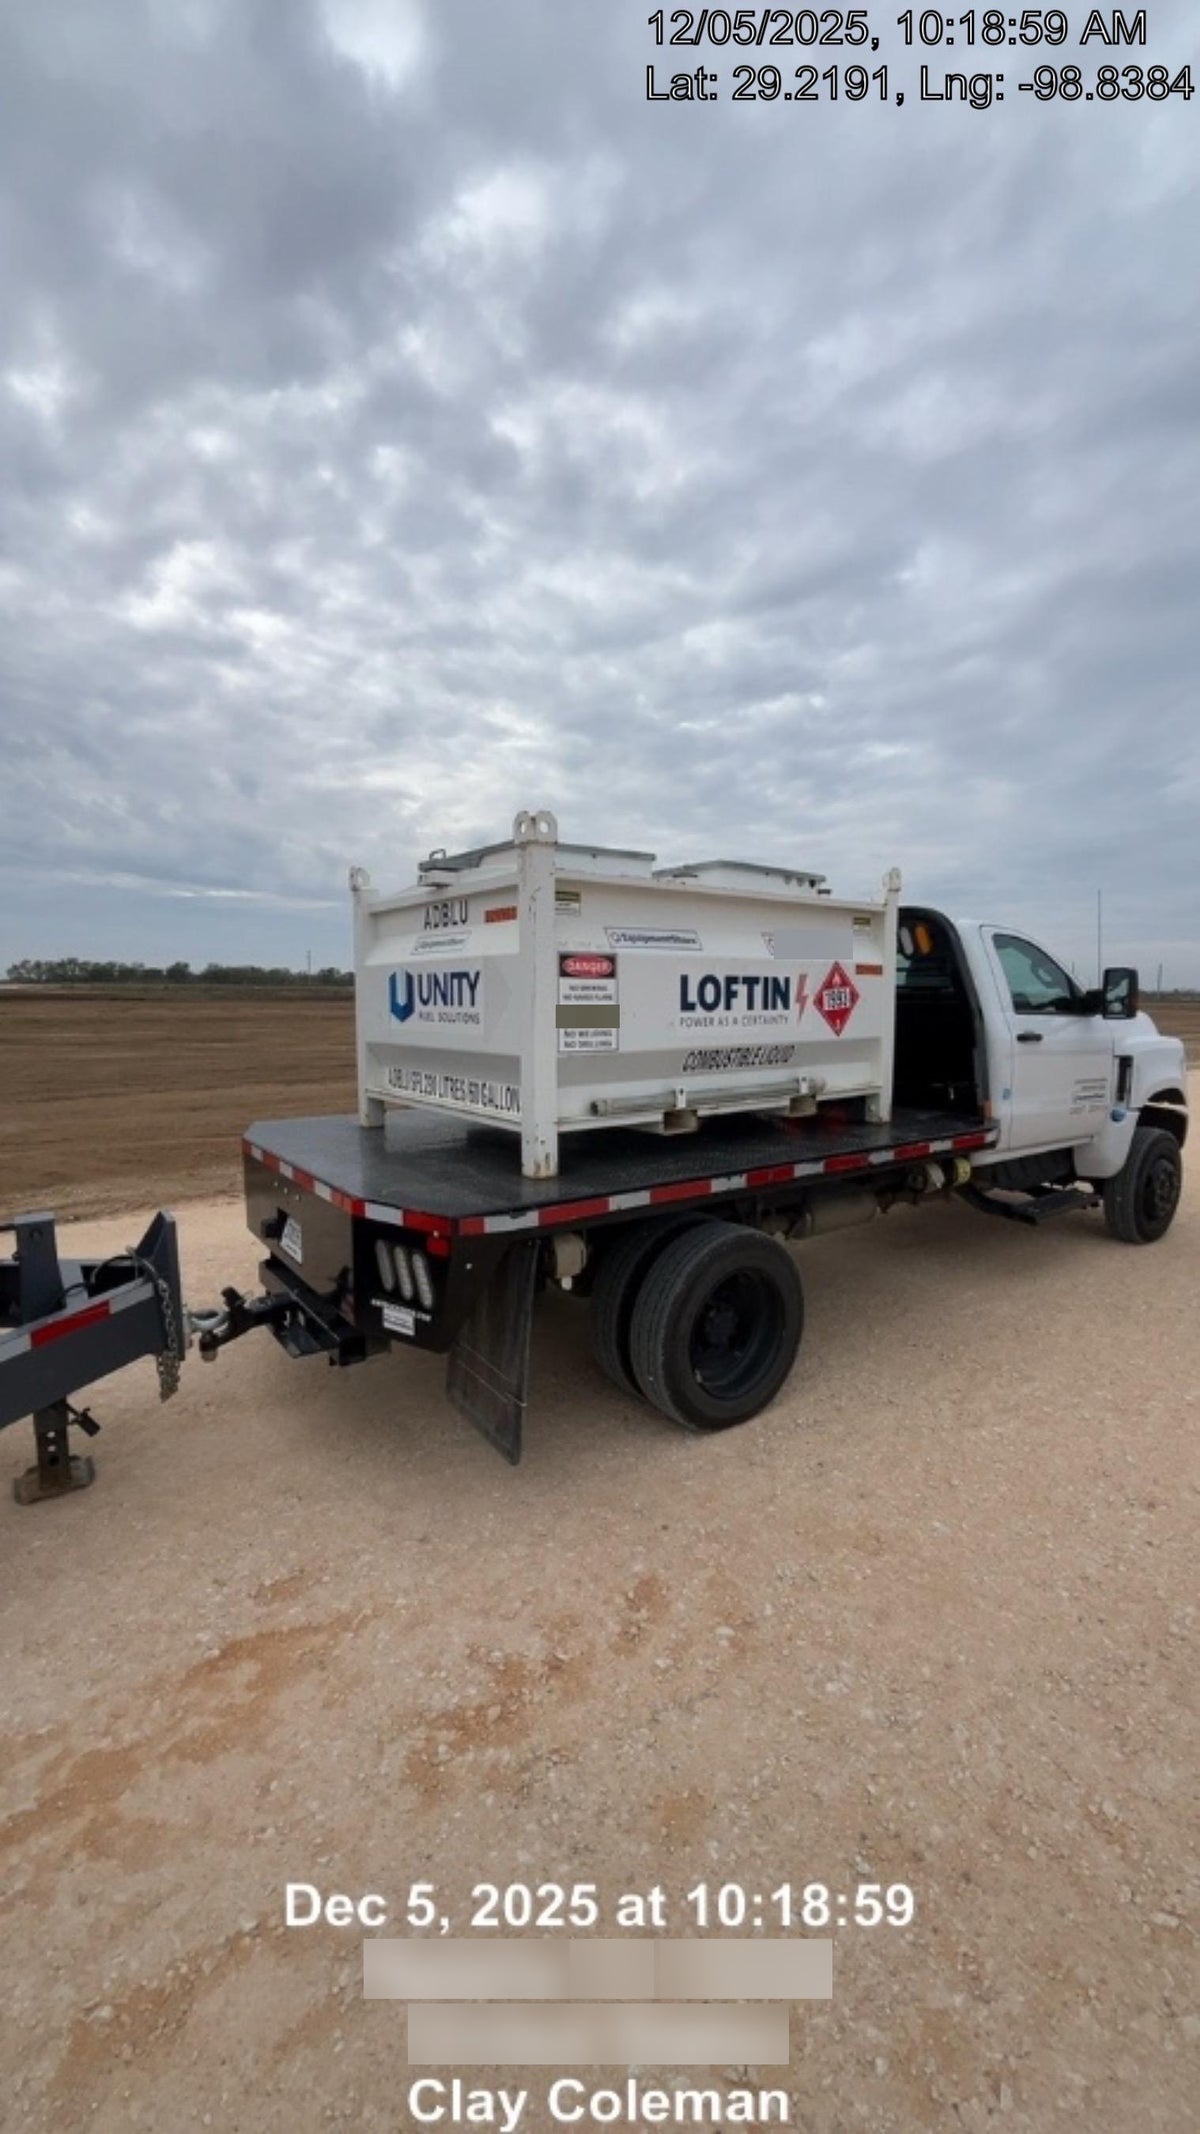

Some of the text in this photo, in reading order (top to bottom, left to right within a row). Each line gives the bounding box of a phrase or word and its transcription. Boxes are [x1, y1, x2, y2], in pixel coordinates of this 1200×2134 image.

[424, 899, 468, 930] ADBLU
[568, 960, 608, 973] DANGER
[417, 971, 480, 1008] UNITY
[680, 974, 790, 1012] LOFTIN
[680, 1016, 715, 1028] POWER
[741, 1014, 789, 1026] CERTAINTY
